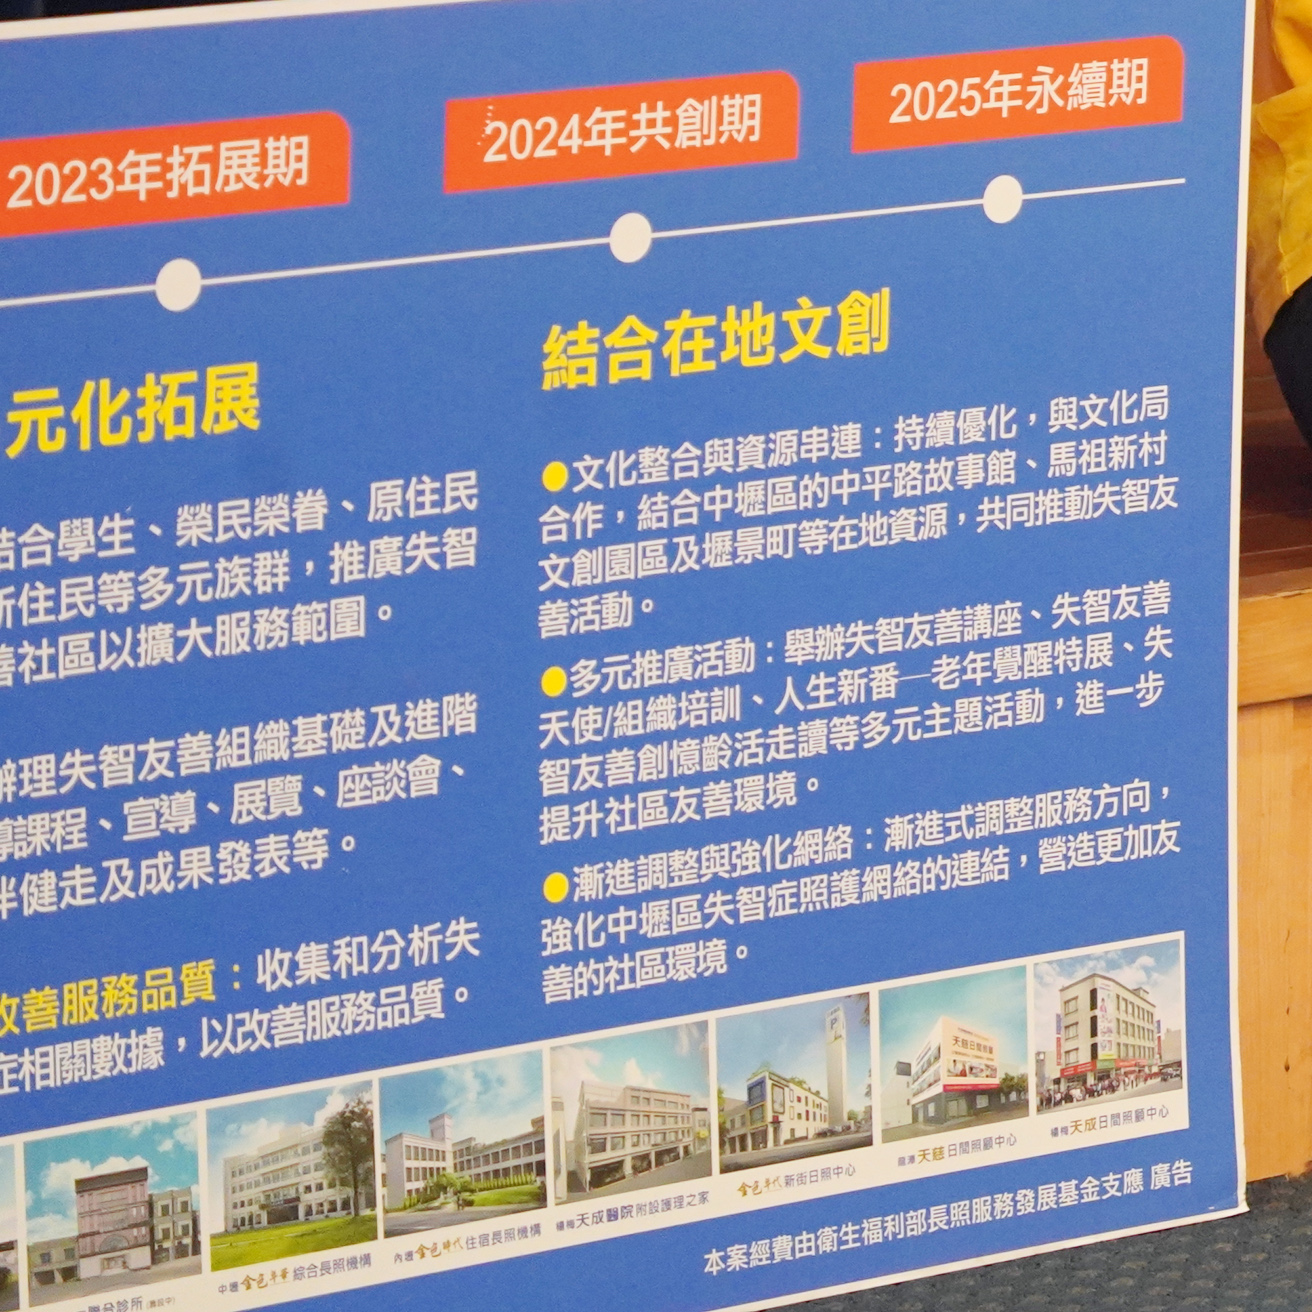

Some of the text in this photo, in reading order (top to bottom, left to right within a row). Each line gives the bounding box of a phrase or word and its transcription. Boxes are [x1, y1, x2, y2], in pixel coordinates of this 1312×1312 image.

[889, 56, 1150, 125] 2025年永續期
[482, 93, 763, 163] 2024年共創期
[6, 135, 309, 209] 2023年拓展期
[541, 288, 892, 392] 結合在地文創
[5, 361, 260, 460] 元化拓展
[537, 589, 654, 639] 善活動。
[538, 770, 820, 846] 提升社區友善環境。
[541, 937, 749, 1005] 善的社區環境。
[703, 1158, 1194, 1276] 本案經費由衛生福利部長照服務發展基金支應 廣告
